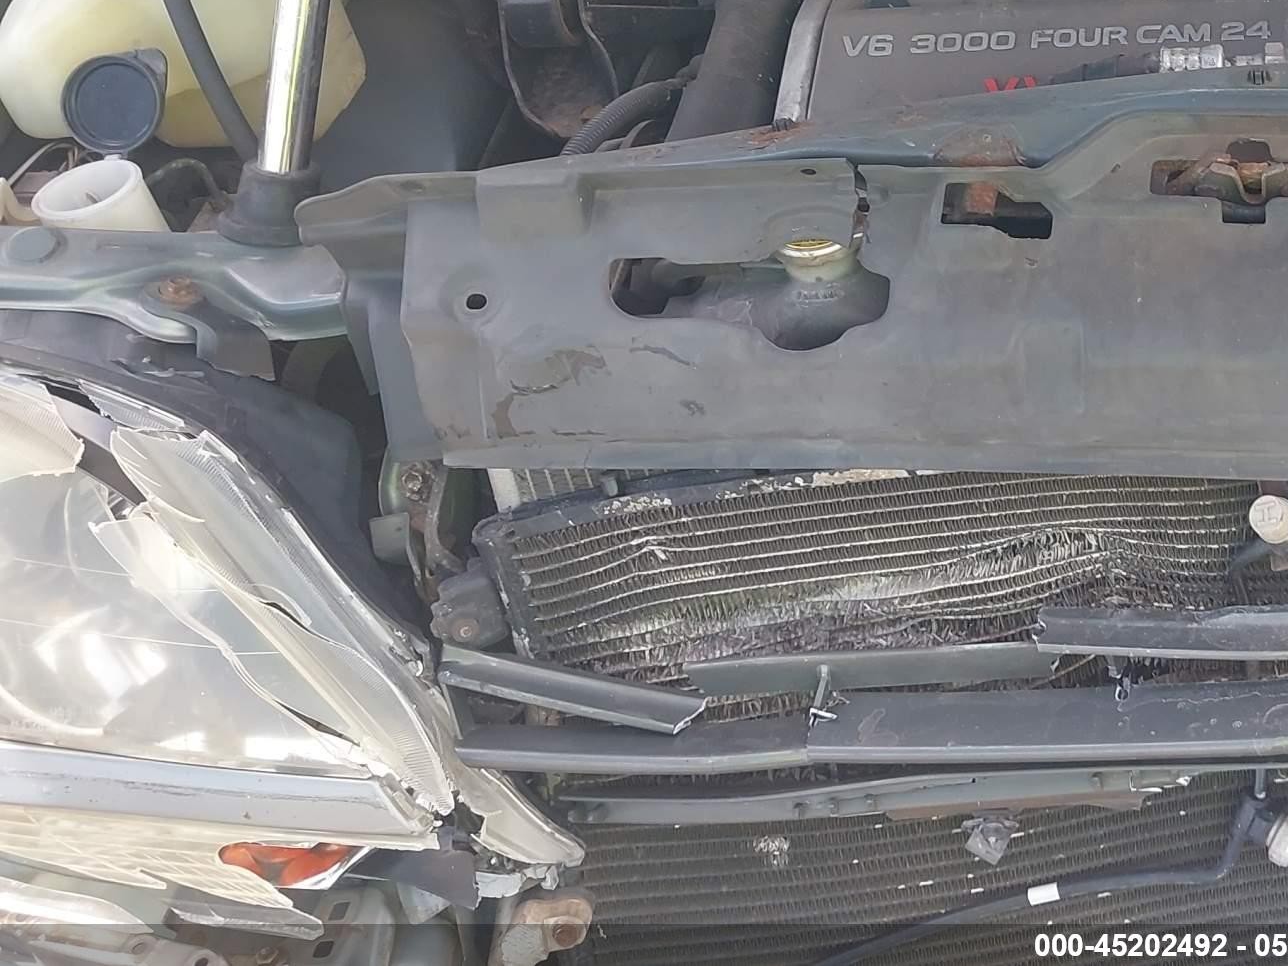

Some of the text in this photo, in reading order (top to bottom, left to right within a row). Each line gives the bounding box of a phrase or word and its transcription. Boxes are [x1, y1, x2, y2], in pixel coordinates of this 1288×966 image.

[842, 20, 1271, 57] V6 3000 FOUR CAM 24
